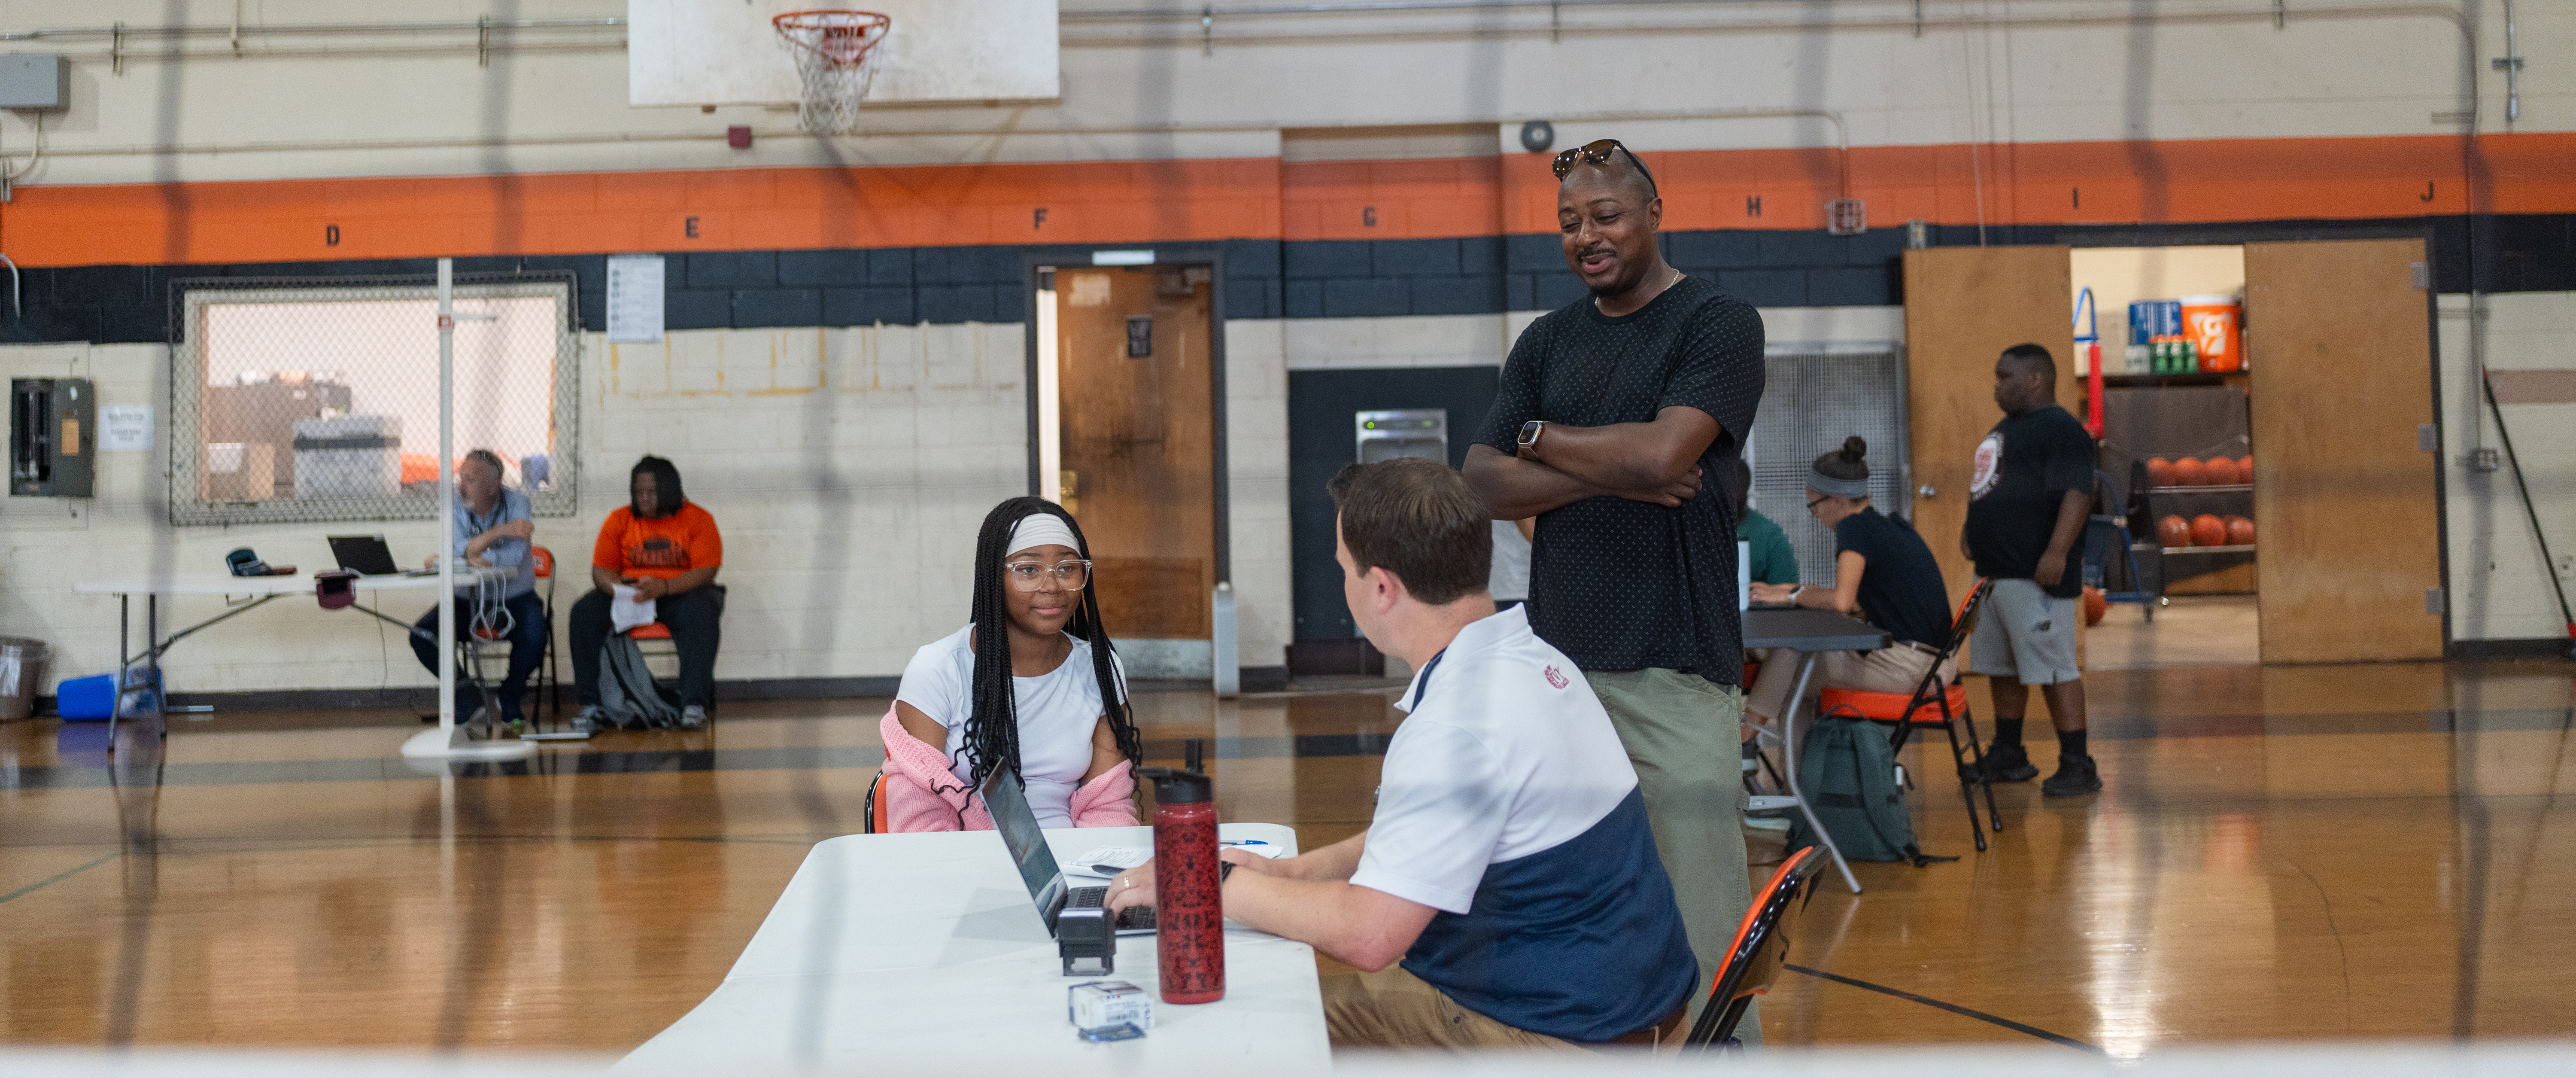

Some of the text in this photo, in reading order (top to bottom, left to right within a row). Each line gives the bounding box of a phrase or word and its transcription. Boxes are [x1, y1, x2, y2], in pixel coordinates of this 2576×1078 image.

[2073, 188, 2079, 209] I
[2420, 181, 2434, 202] J
[1747, 196, 1761, 216] H
[686, 217, 699, 238] E
[1034, 208, 1048, 229] F
[1363, 207, 1376, 227] G
[327, 225, 340, 246] D
[2203, 315, 2222, 336] G
